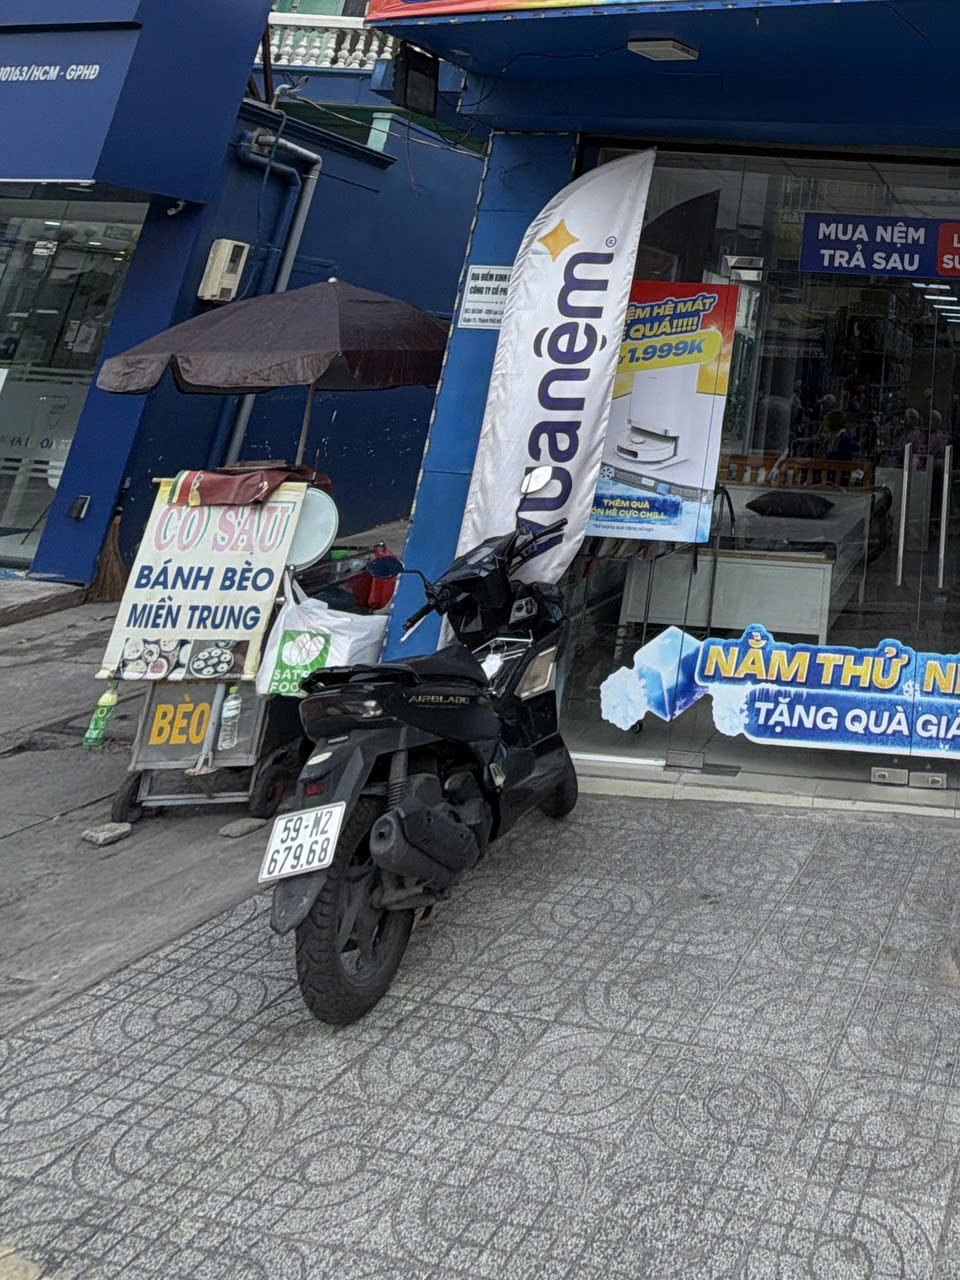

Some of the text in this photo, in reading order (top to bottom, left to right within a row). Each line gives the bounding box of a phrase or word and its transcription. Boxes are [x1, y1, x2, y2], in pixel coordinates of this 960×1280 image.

[818, 221, 925, 249] MUA NỆM
[820, 244, 920, 272] TRẢ SAU
[626, 296, 714, 322] ỆM HÈ MÁT
[627, 337, 705, 364] 1.999K
[590, 506, 605, 515] ÓN
[602, 498, 650, 509] THÊM QUÀ
[134, 558, 275, 592] BÁNH BÈO
[126, 595, 262, 630] MIỀN TRUNG
[815, 646, 909, 690] THỬ
[270, 681, 300, 693] FOO
[148, 691, 211, 745] BÈO
[754, 696, 839, 733] TẶNG
[844, 705, 911, 736] QUÀ
[266, 837, 332, 876] 679.68
